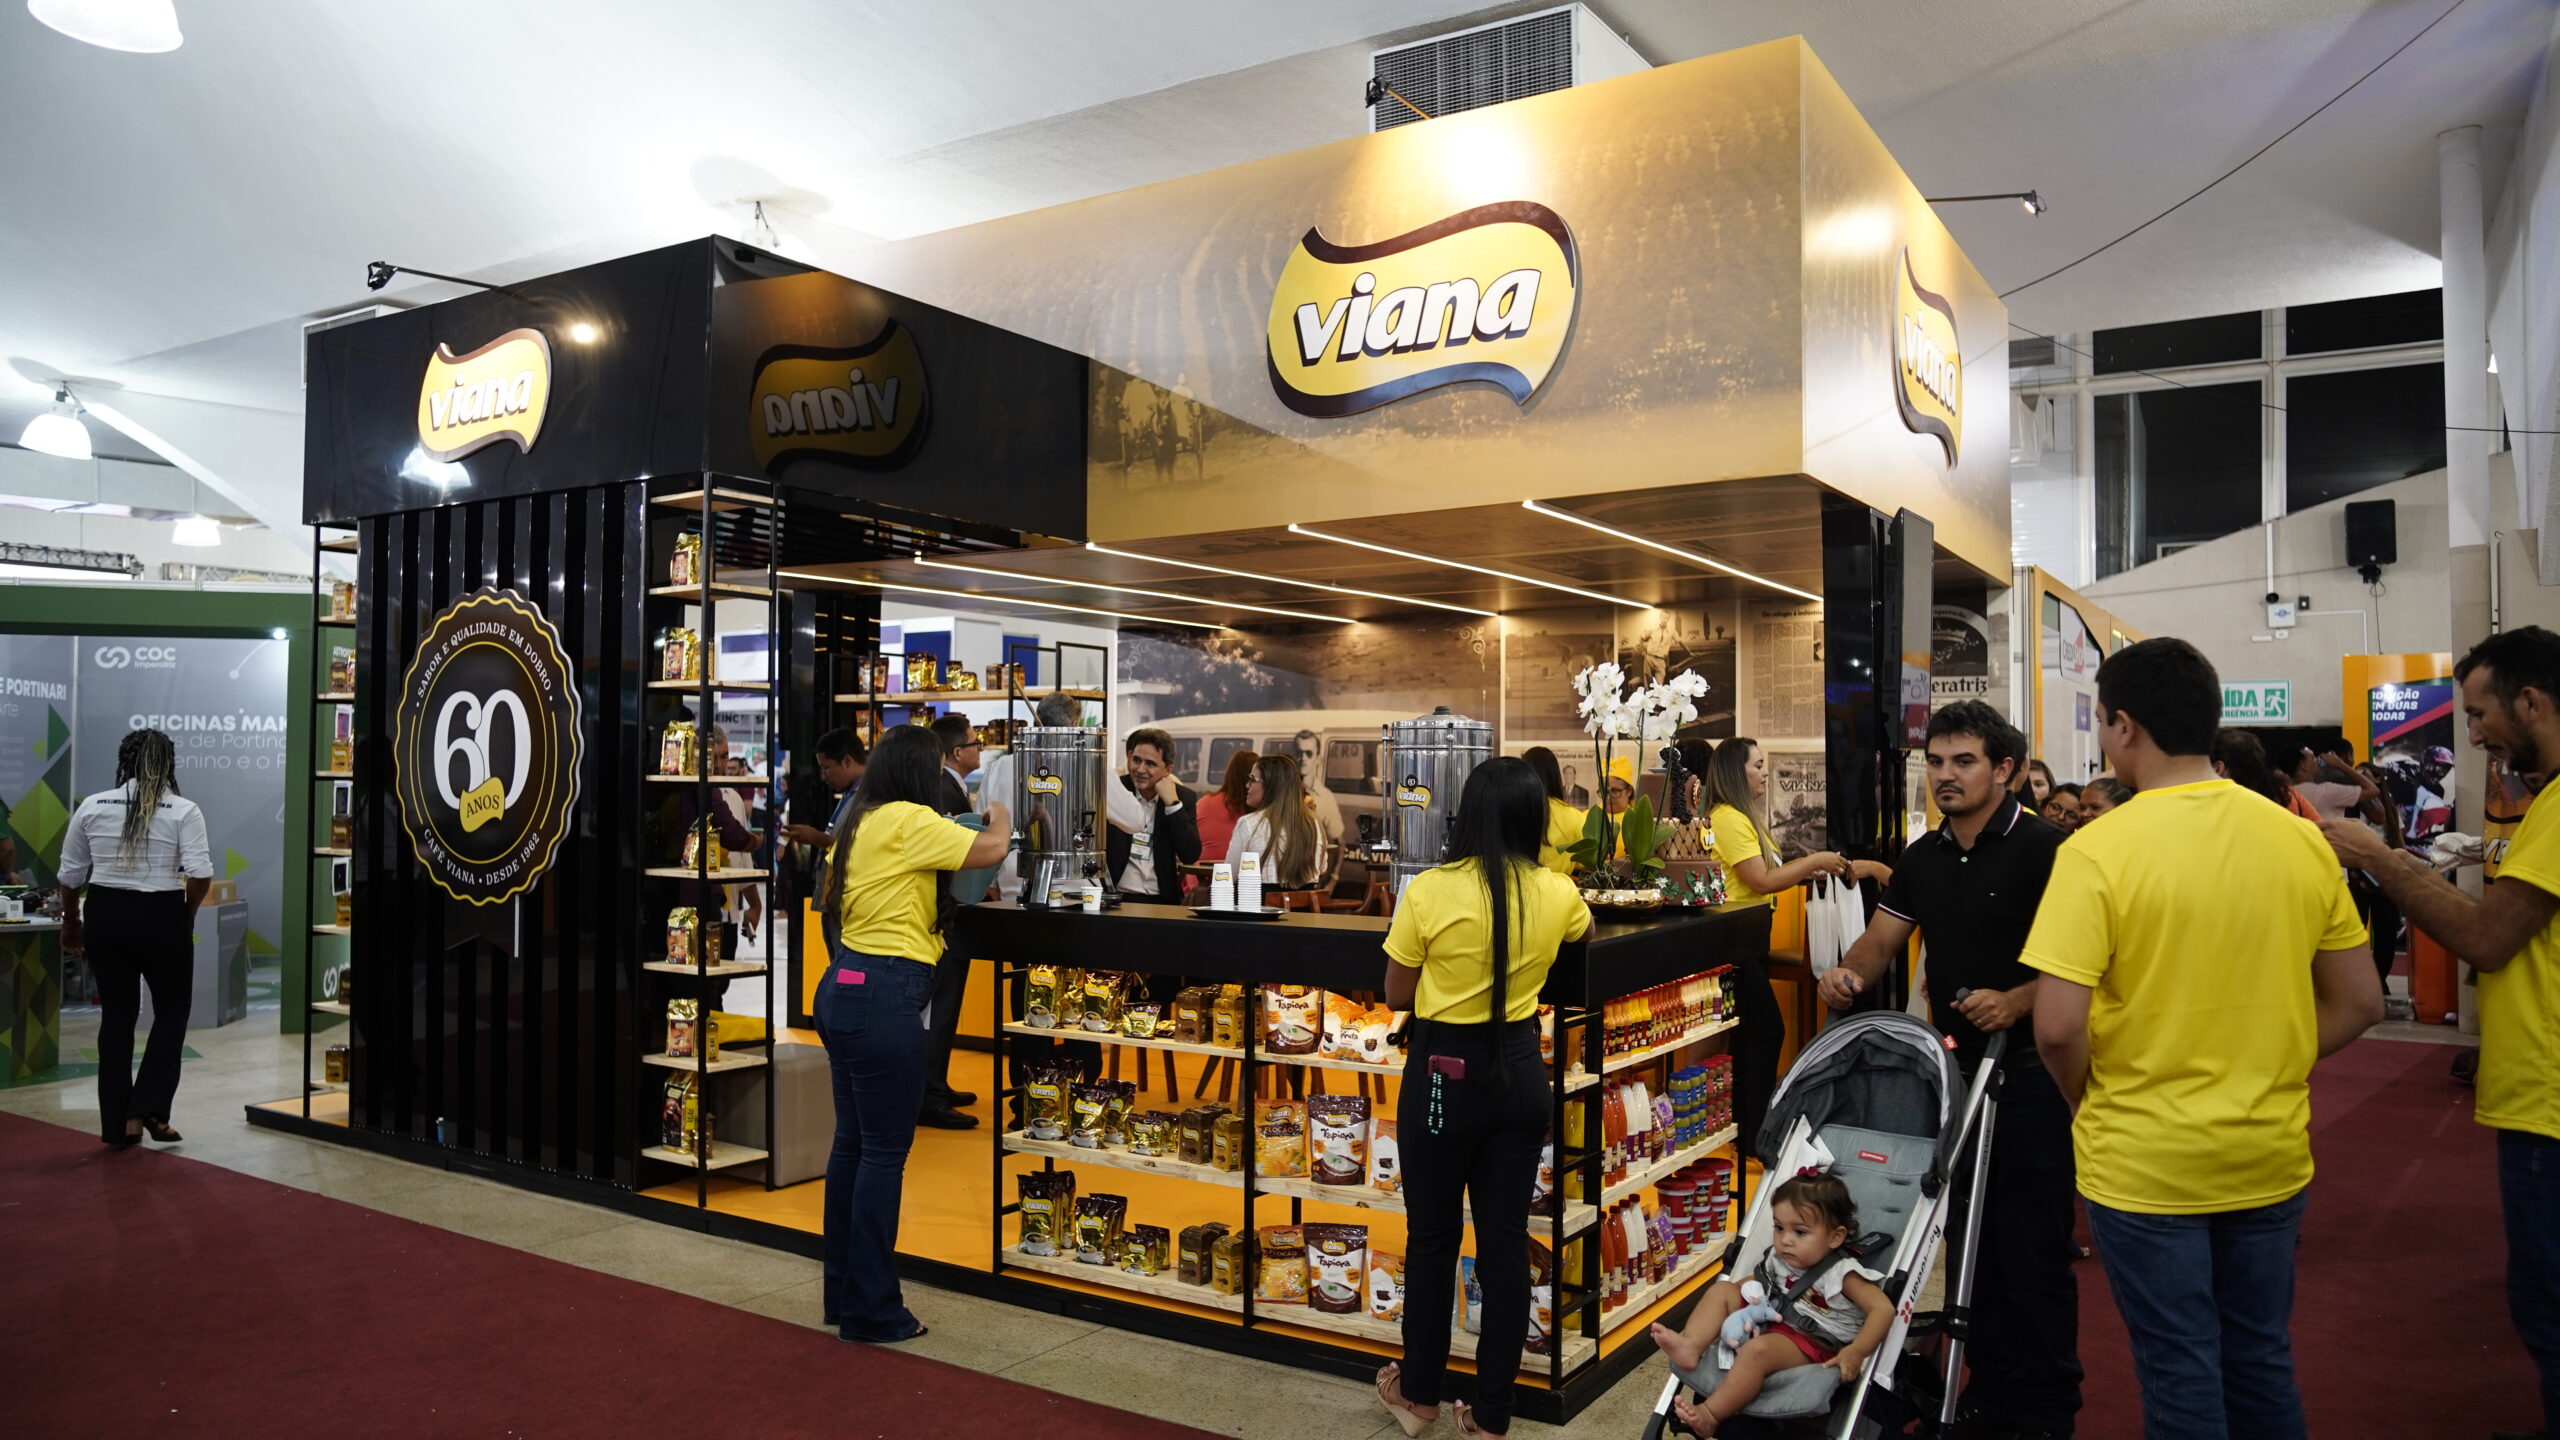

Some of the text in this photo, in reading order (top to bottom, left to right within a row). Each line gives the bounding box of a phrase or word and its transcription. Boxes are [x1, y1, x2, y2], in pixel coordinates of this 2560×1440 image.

[1293, 268, 1542, 367] viana
[1903, 309, 1957, 418] viana
[430, 370, 534, 432] viana
[134, 646, 176, 661] COC
[417, 621, 551, 698] SABOR E QUALIDADE EM DOBRO
[6, 677, 67, 700] PORTINARI
[2387, 700, 2419, 710] DUAS
[129, 714, 236, 731] OFICINAS
[189, 733, 216, 749] de
[434, 689, 532, 810] 60
[237, 755, 250, 769] e
[256, 755, 270, 769] o
[1030, 779, 1058, 791] viana
[1779, 779, 1825, 793] VIANA
[1398, 789, 1427, 803] viana
[466, 794, 500, 818] ANOS
[424, 828, 540, 885] CAFÉ VIANA DESDE 1962
[1031, 1085, 1057, 1097] viana
[1321, 1128, 1355, 1140] Tapioca
[1025, 1199, 1051, 1211] viana
[1317, 1255, 1351, 1267] Tapioca
